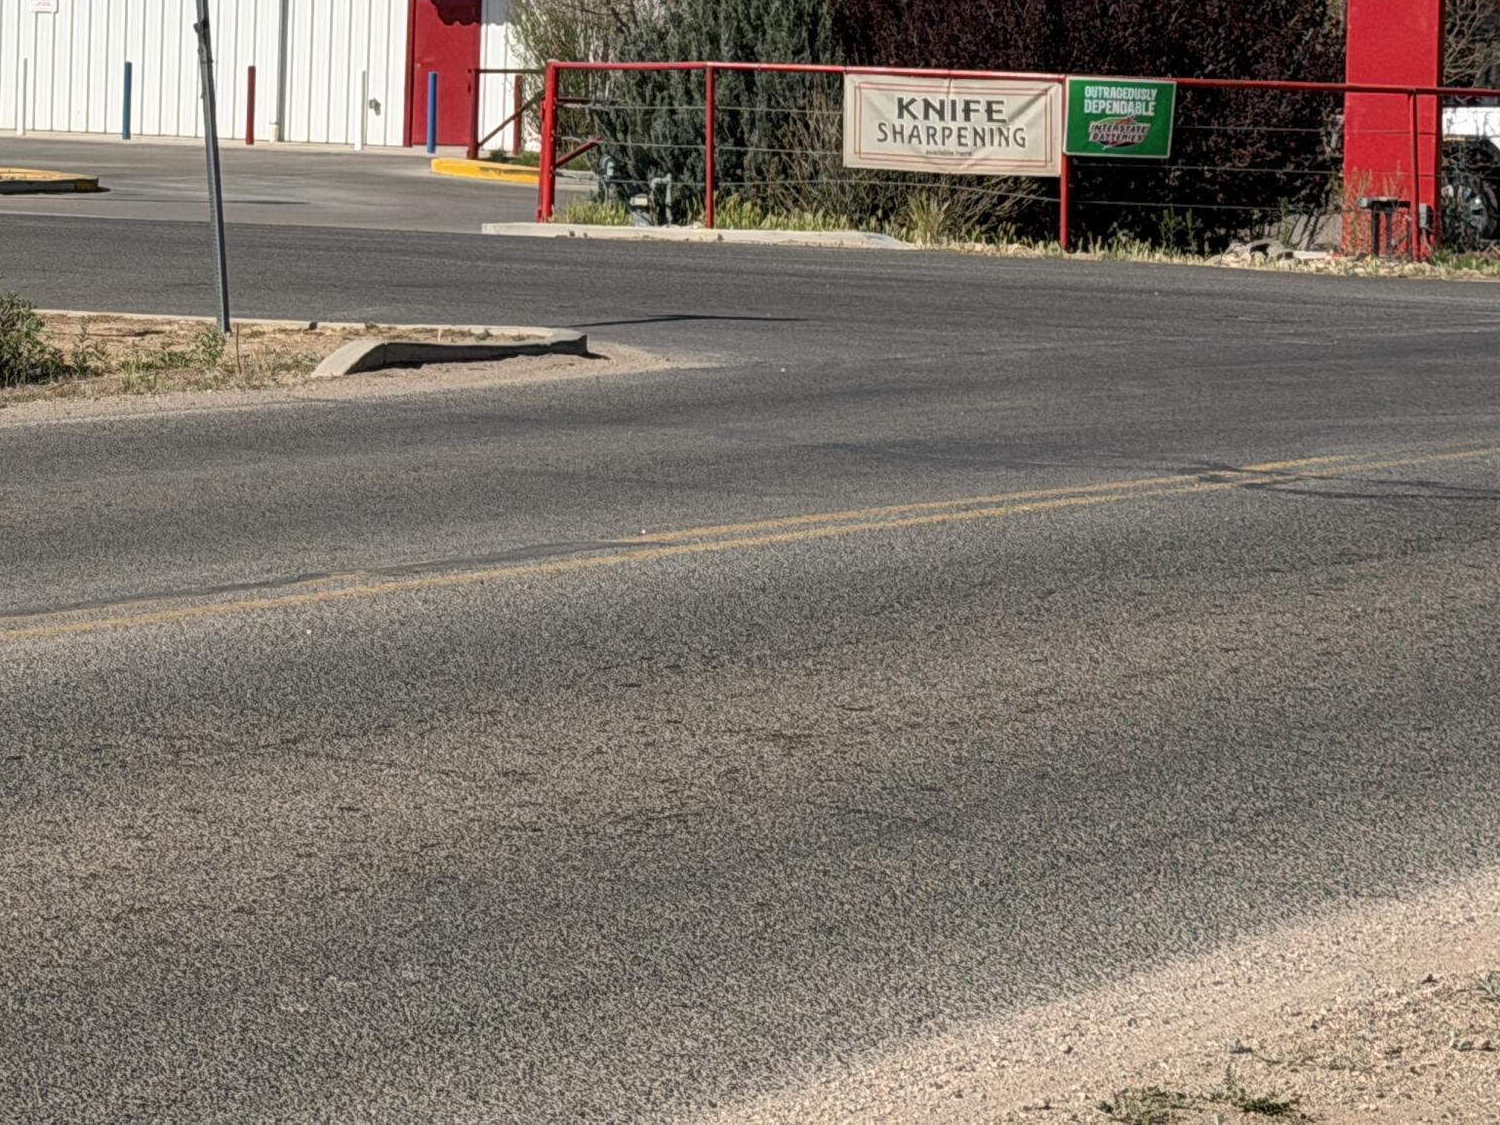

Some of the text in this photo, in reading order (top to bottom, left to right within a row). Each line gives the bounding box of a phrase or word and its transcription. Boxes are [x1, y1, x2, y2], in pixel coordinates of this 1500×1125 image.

[1084, 85, 1158, 101] OUTRAGEOUSLY
[896, 97, 1007, 123] KNIFE
[1084, 99, 1156, 116] DEPENDABLE
[876, 122, 1027, 149] SHARPENING
